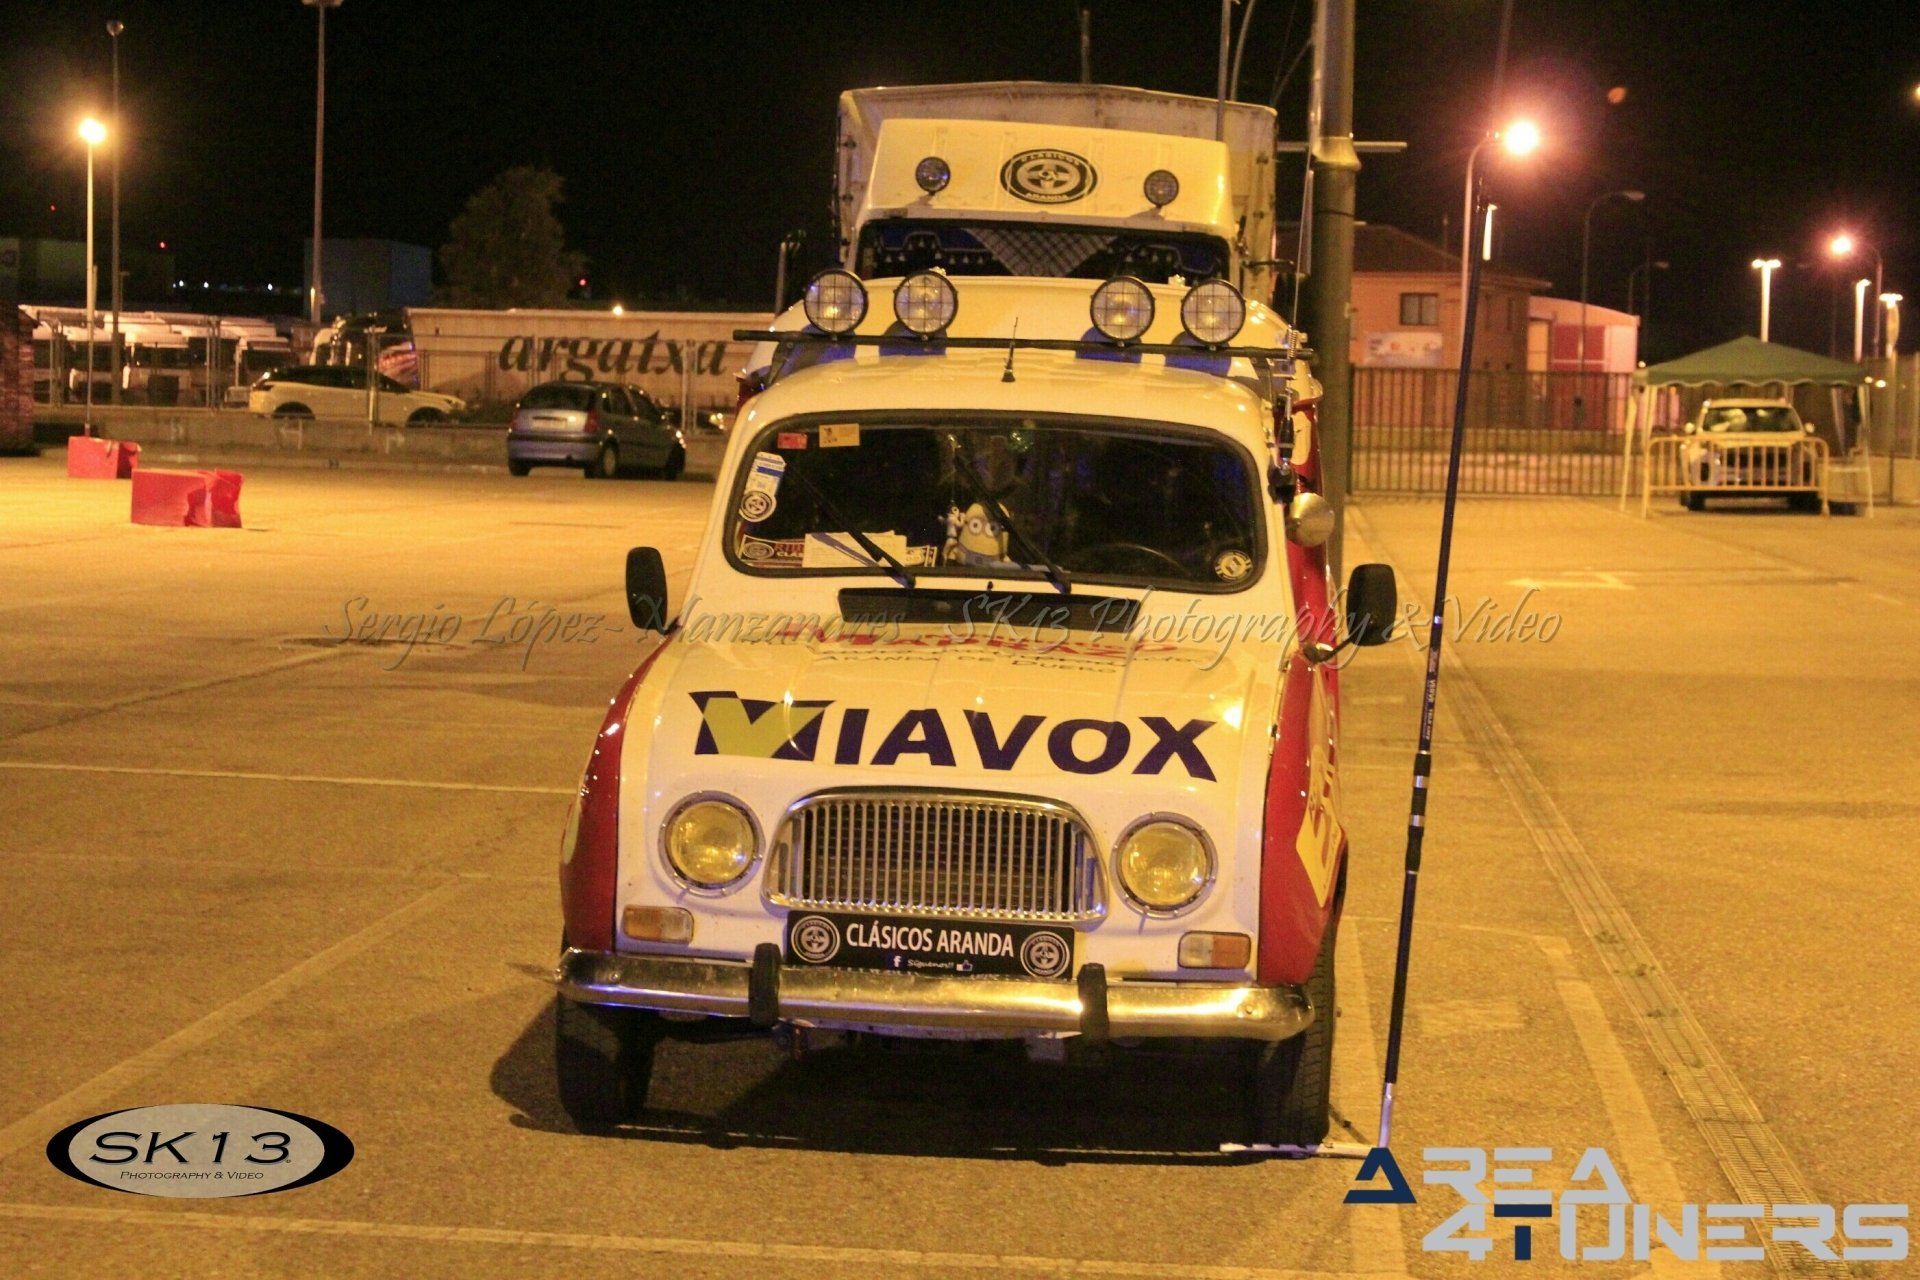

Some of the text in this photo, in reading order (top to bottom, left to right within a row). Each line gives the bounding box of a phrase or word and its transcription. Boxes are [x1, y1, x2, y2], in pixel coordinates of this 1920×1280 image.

[499, 330, 728, 382] argatxa
[689, 690, 1218, 783] VIAVOX
[846, 920, 1014, 958] CLÁSICOS ARANDA
